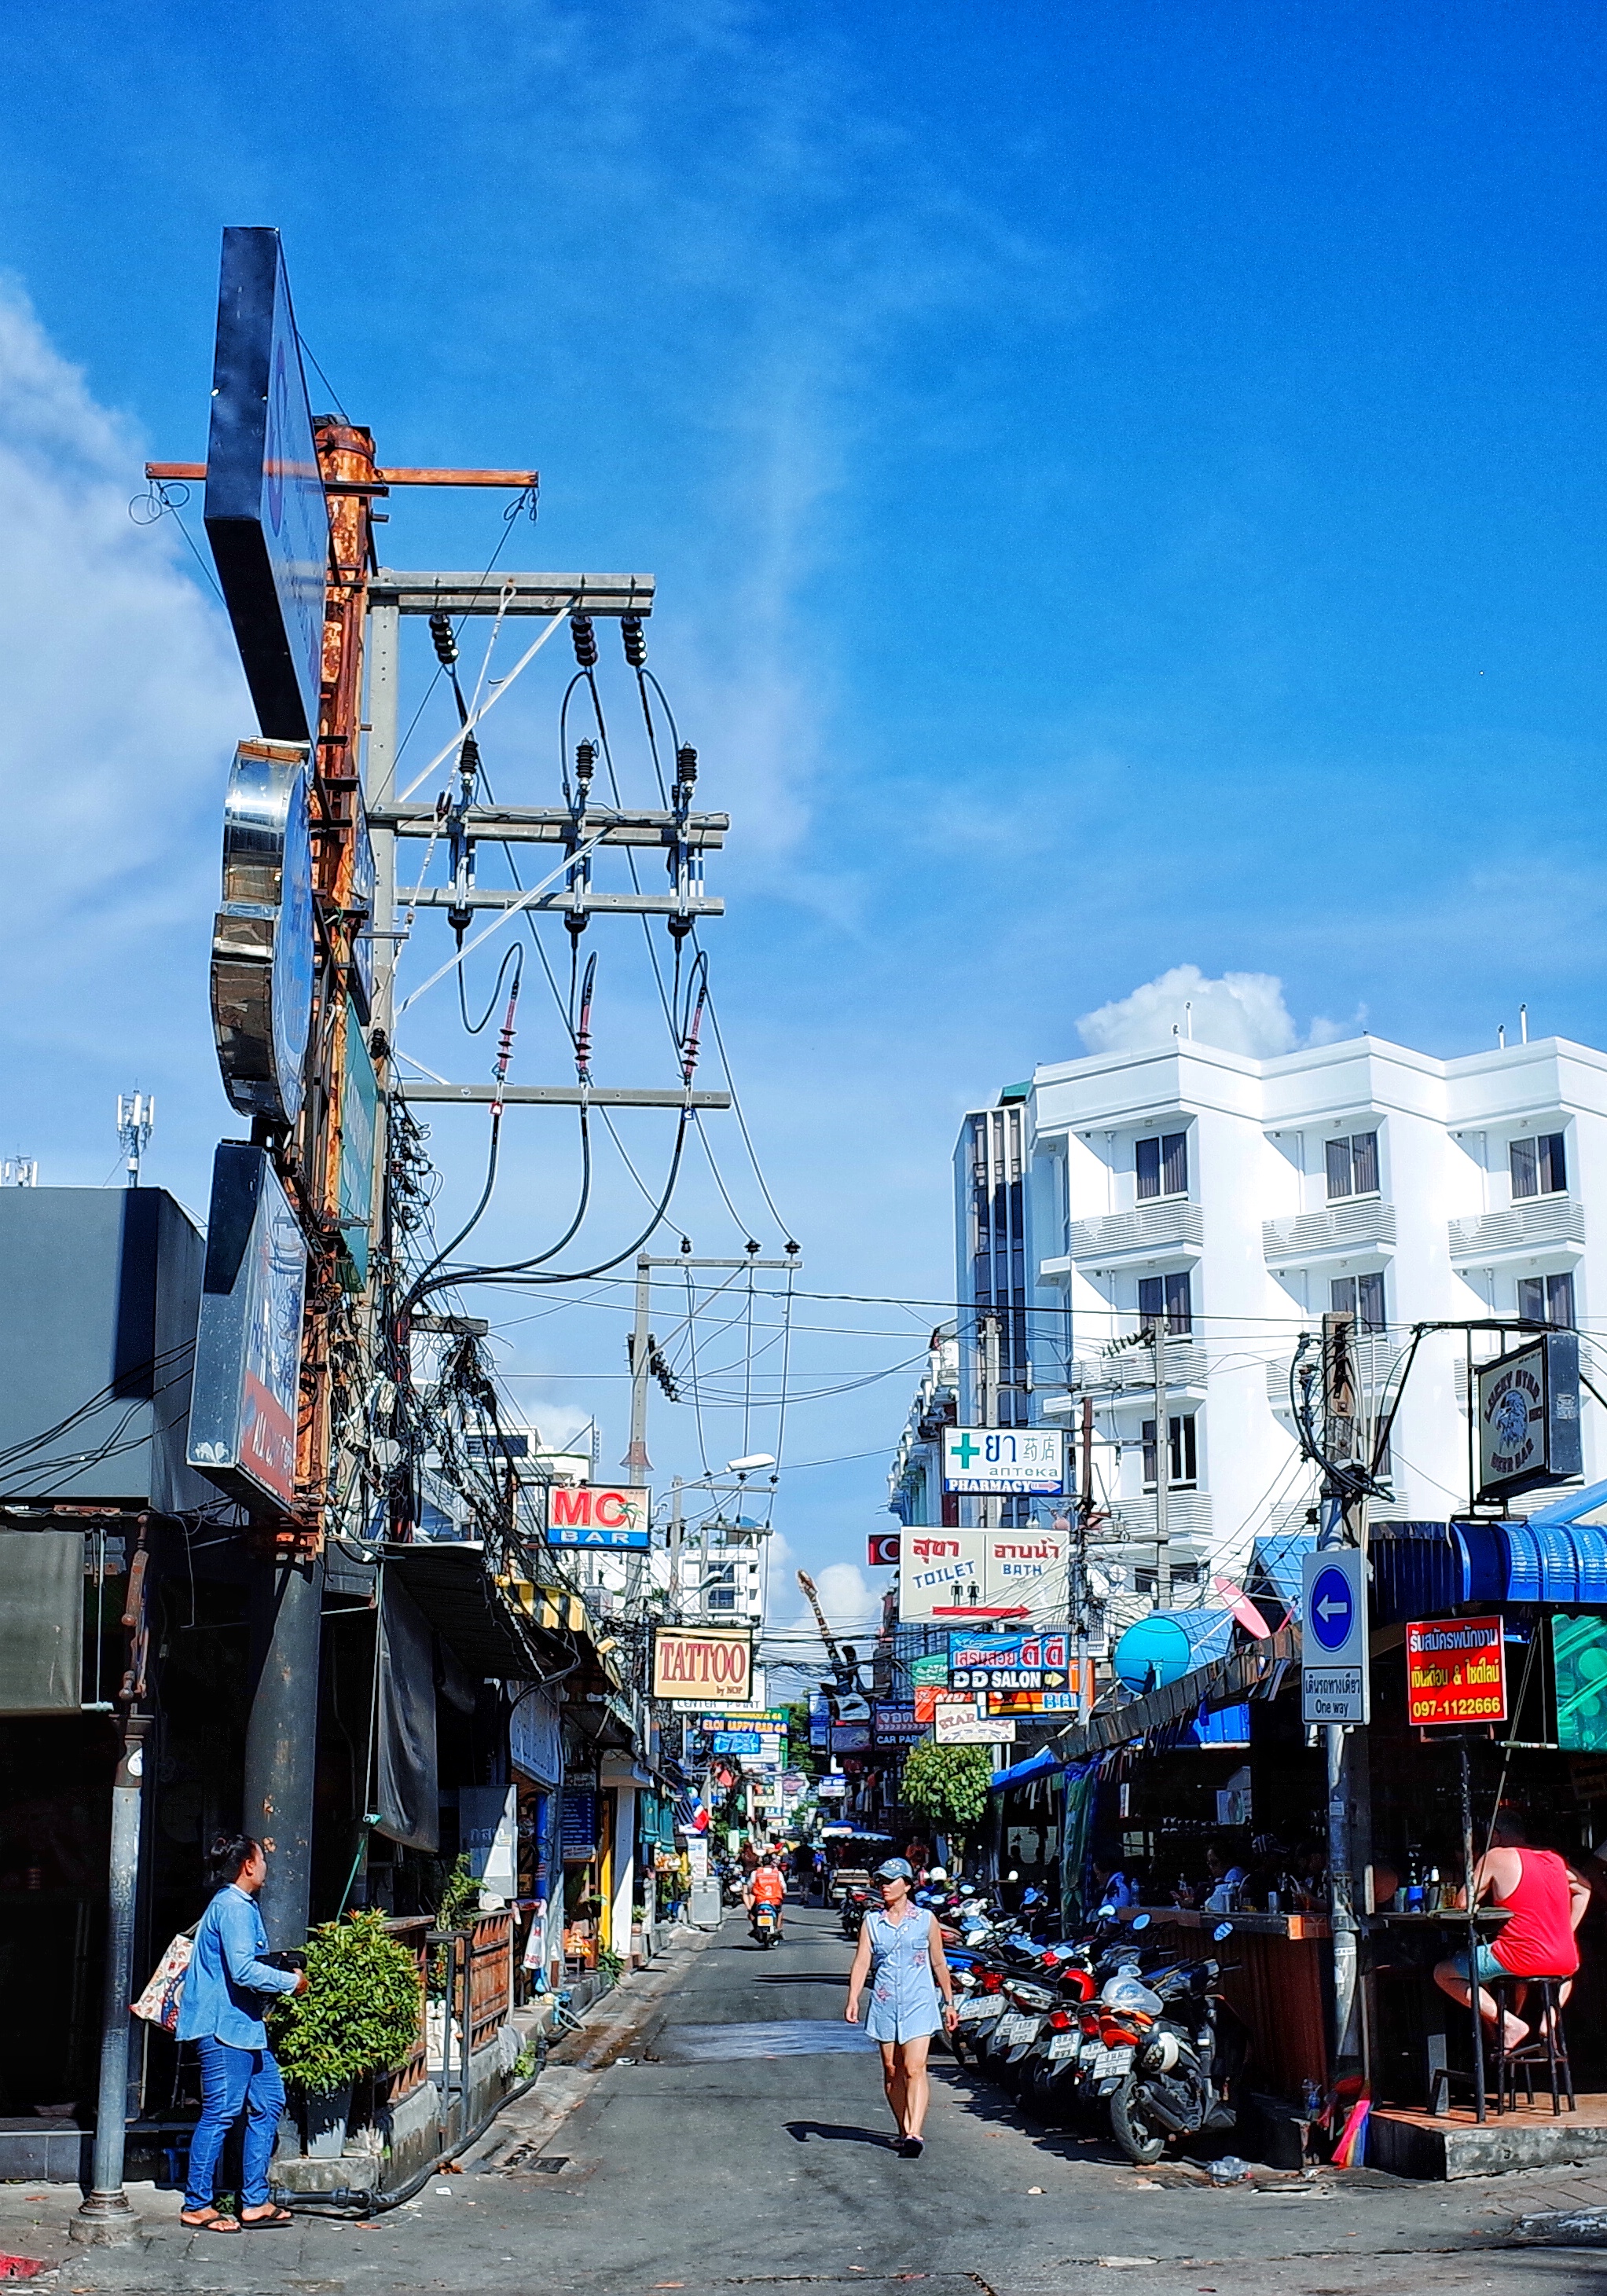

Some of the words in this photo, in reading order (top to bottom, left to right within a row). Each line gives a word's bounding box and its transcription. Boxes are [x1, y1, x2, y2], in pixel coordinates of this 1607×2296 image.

[985, 1434, 1017, 1462] ยา
[1023, 1436, 1055, 1462] 药店
[989, 1467, 1058, 1477] аптека
[948, 1480, 1032, 1492] PHARMACY
[554, 1491, 627, 1528] MC
[561, 1530, 630, 1544] BAR
[993, 1536, 1060, 1559] อาบน้ำ
[912, 1538, 959, 1564] สุขา
[912, 1560, 975, 1588] TOILET
[1003, 1564, 1042, 1575] BATH
[1410, 1625, 1499, 1652] รับสมัครพนักงาน
[659, 1641, 746, 1683] TATTOO
[991, 1671, 1042, 1688] SALON
[1305, 1672, 1359, 1694] เดินรถทางเดียว
[1411, 1663, 1447, 1688] เงินเดือน
[1453, 1664, 1462, 1685] &
[1315, 1699, 1331, 1714] One
[1333, 1702, 1349, 1718] way
[1413, 1696, 1501, 1718] 097-1122666
[938, 1712, 976, 1730] STAR
[876, 1735, 896, 1744] CAR
